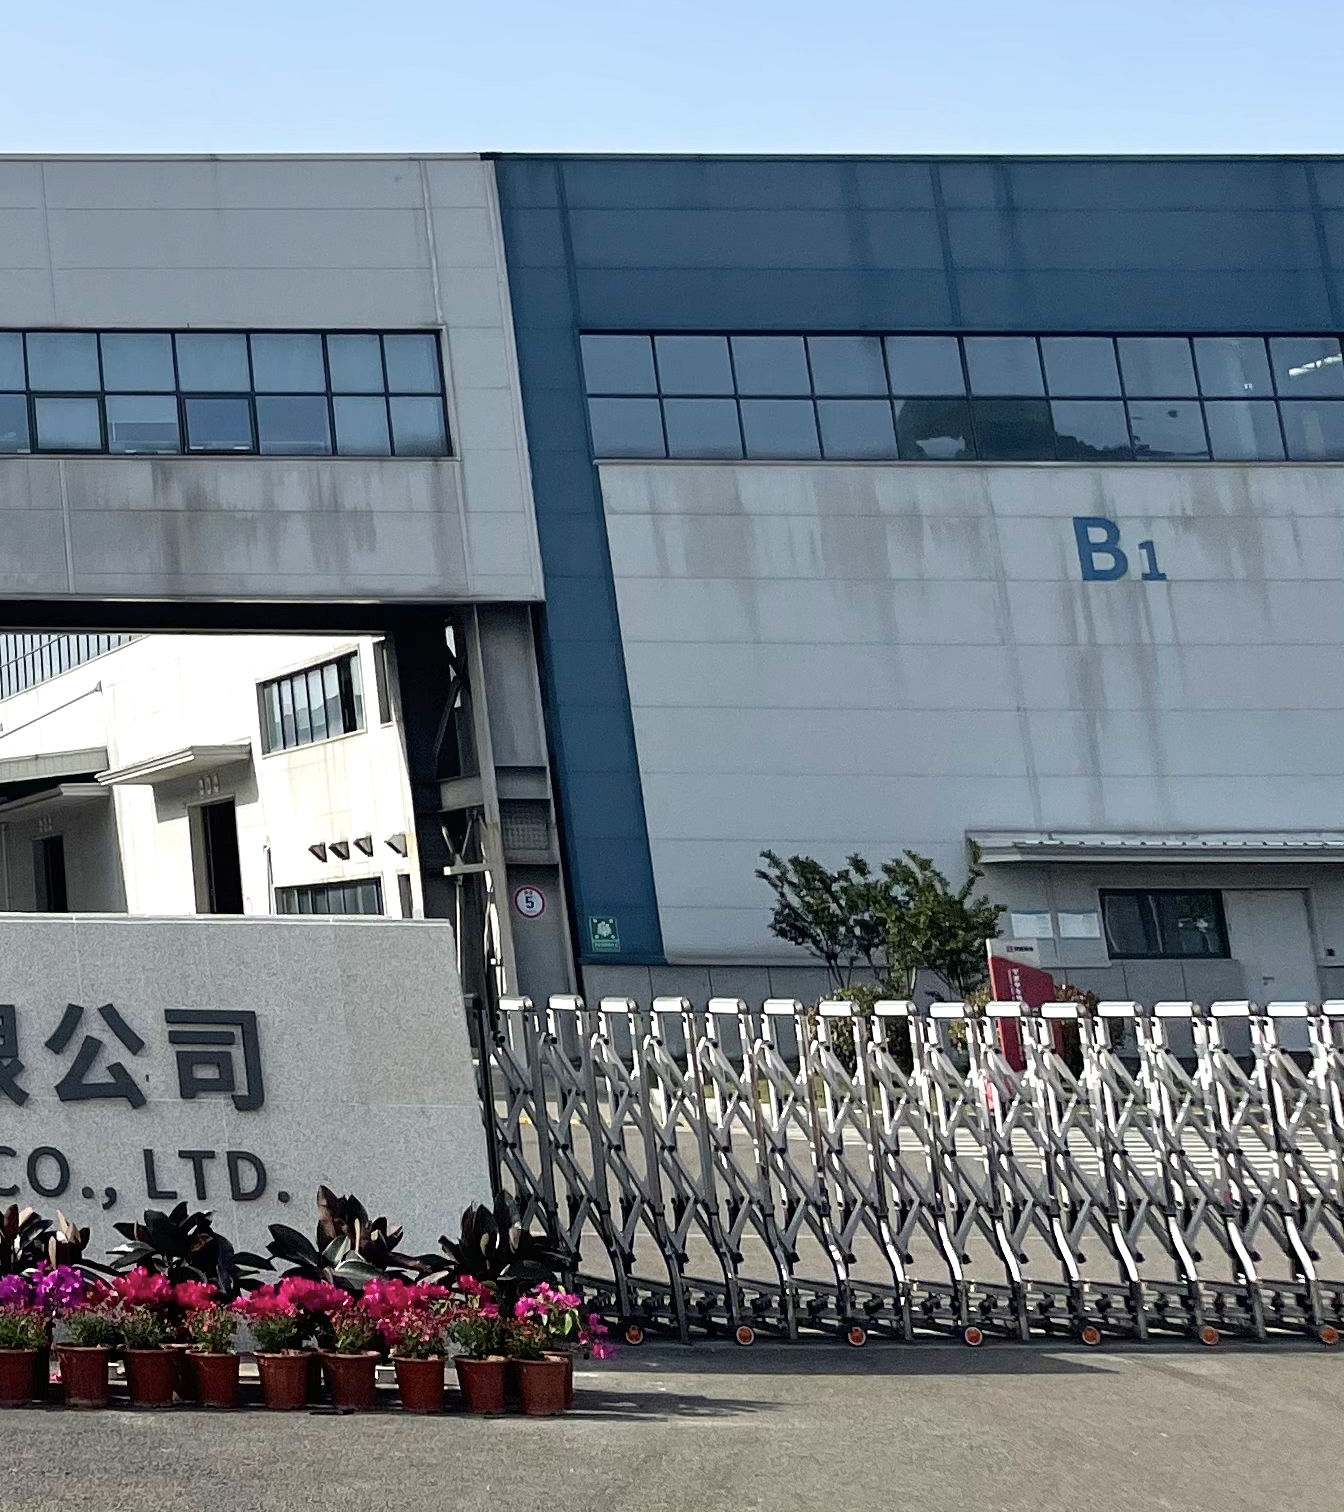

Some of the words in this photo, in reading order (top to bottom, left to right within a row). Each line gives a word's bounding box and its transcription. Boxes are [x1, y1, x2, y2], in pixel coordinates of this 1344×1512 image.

[1072, 516, 1167, 581] B1
[525, 896, 534, 909] 5
[144, 1148, 291, 1205] LTD.
